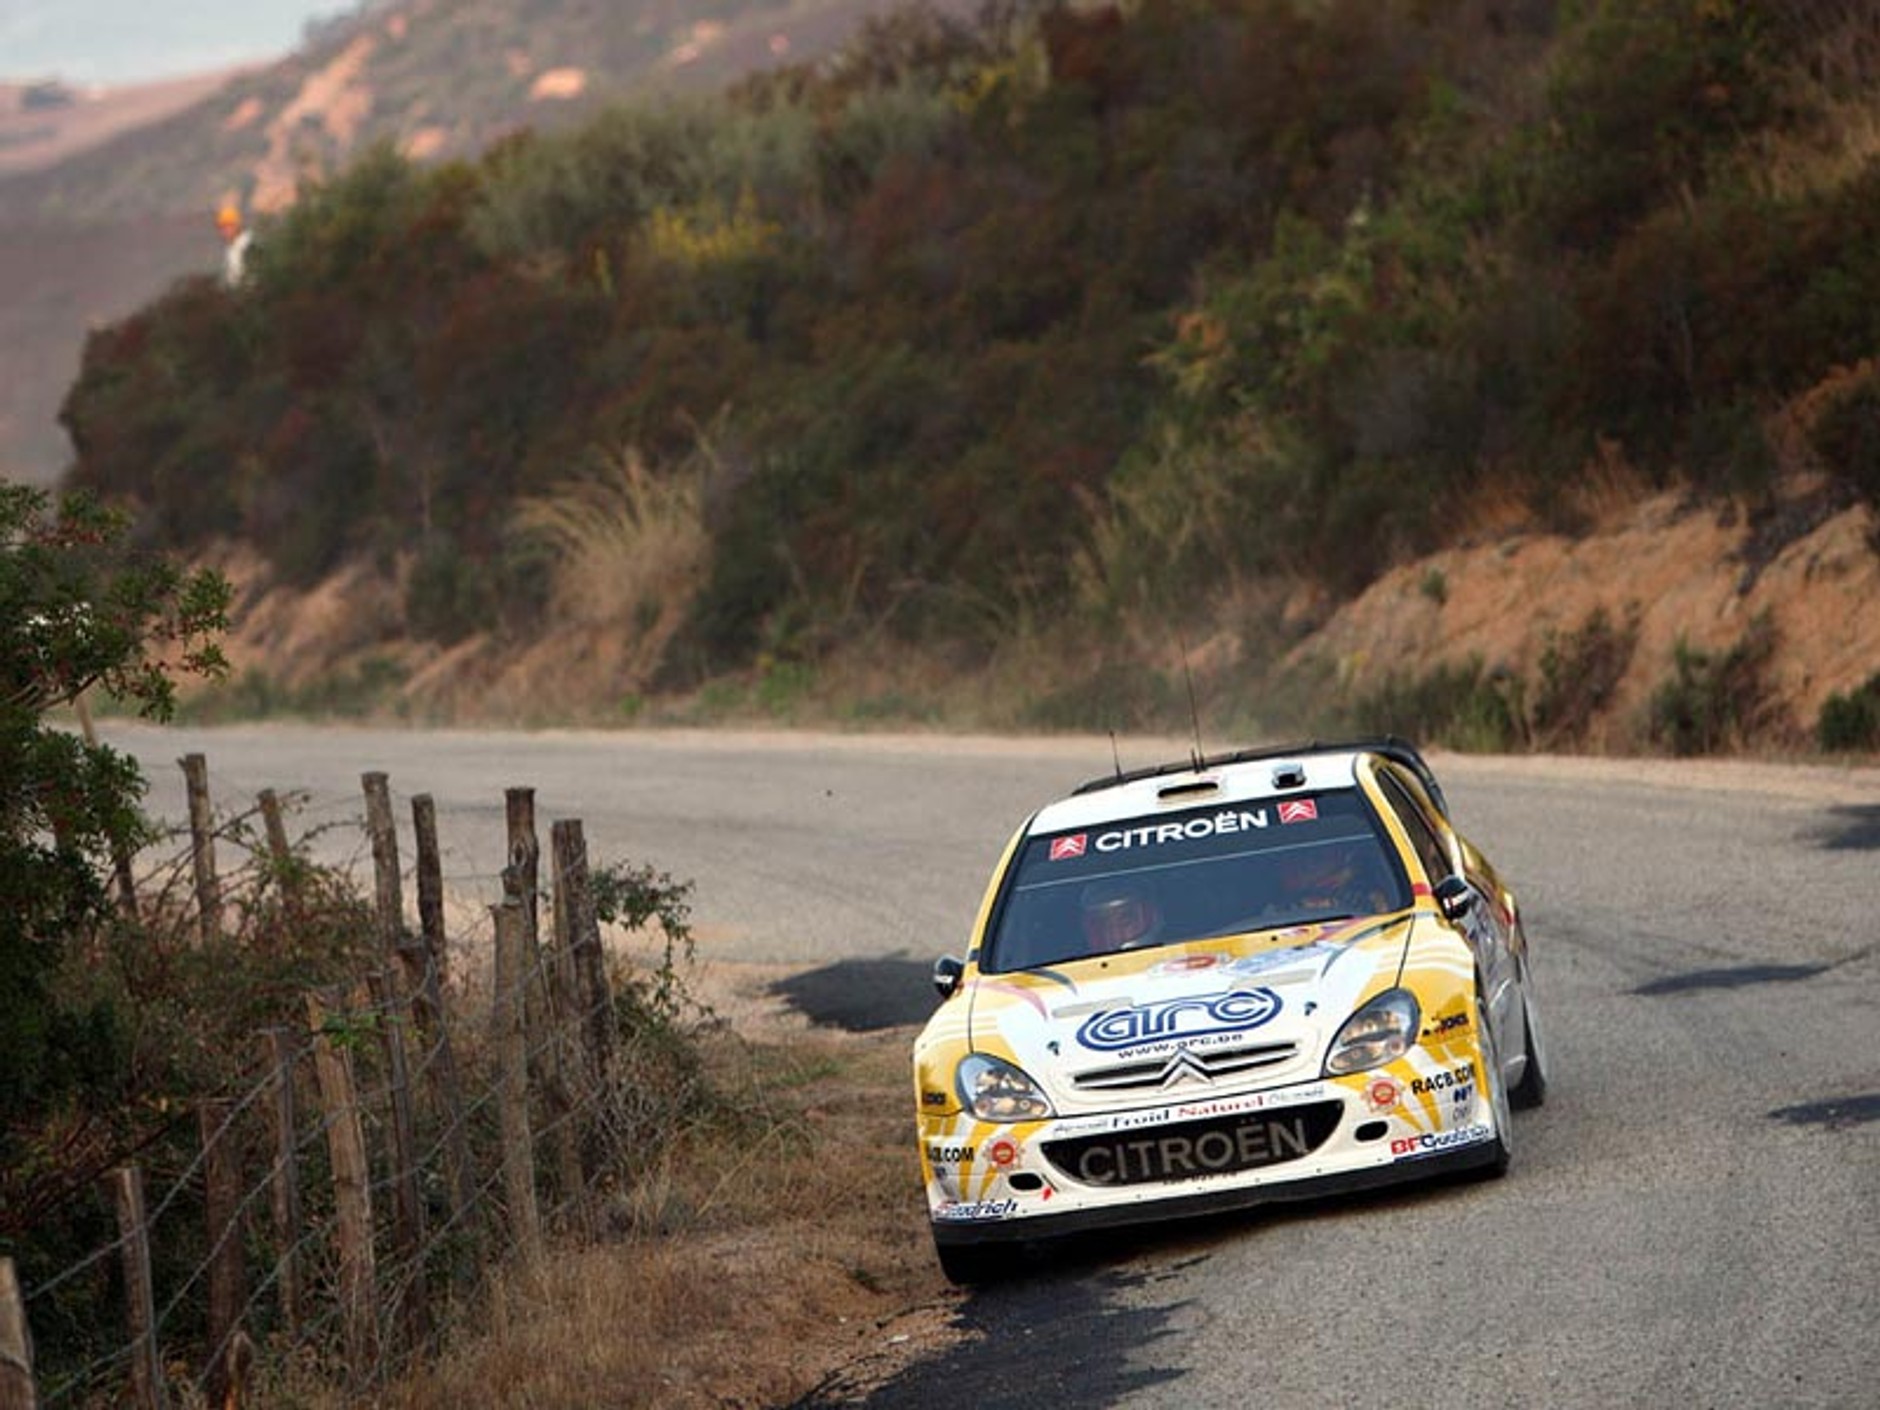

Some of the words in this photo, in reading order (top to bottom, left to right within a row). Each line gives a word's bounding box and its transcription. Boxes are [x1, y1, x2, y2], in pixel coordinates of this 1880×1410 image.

[1095, 809, 1269, 852] CITROËN
[1080, 989, 1280, 1050] arc
[1078, 1116, 1309, 1183] CITROËN
